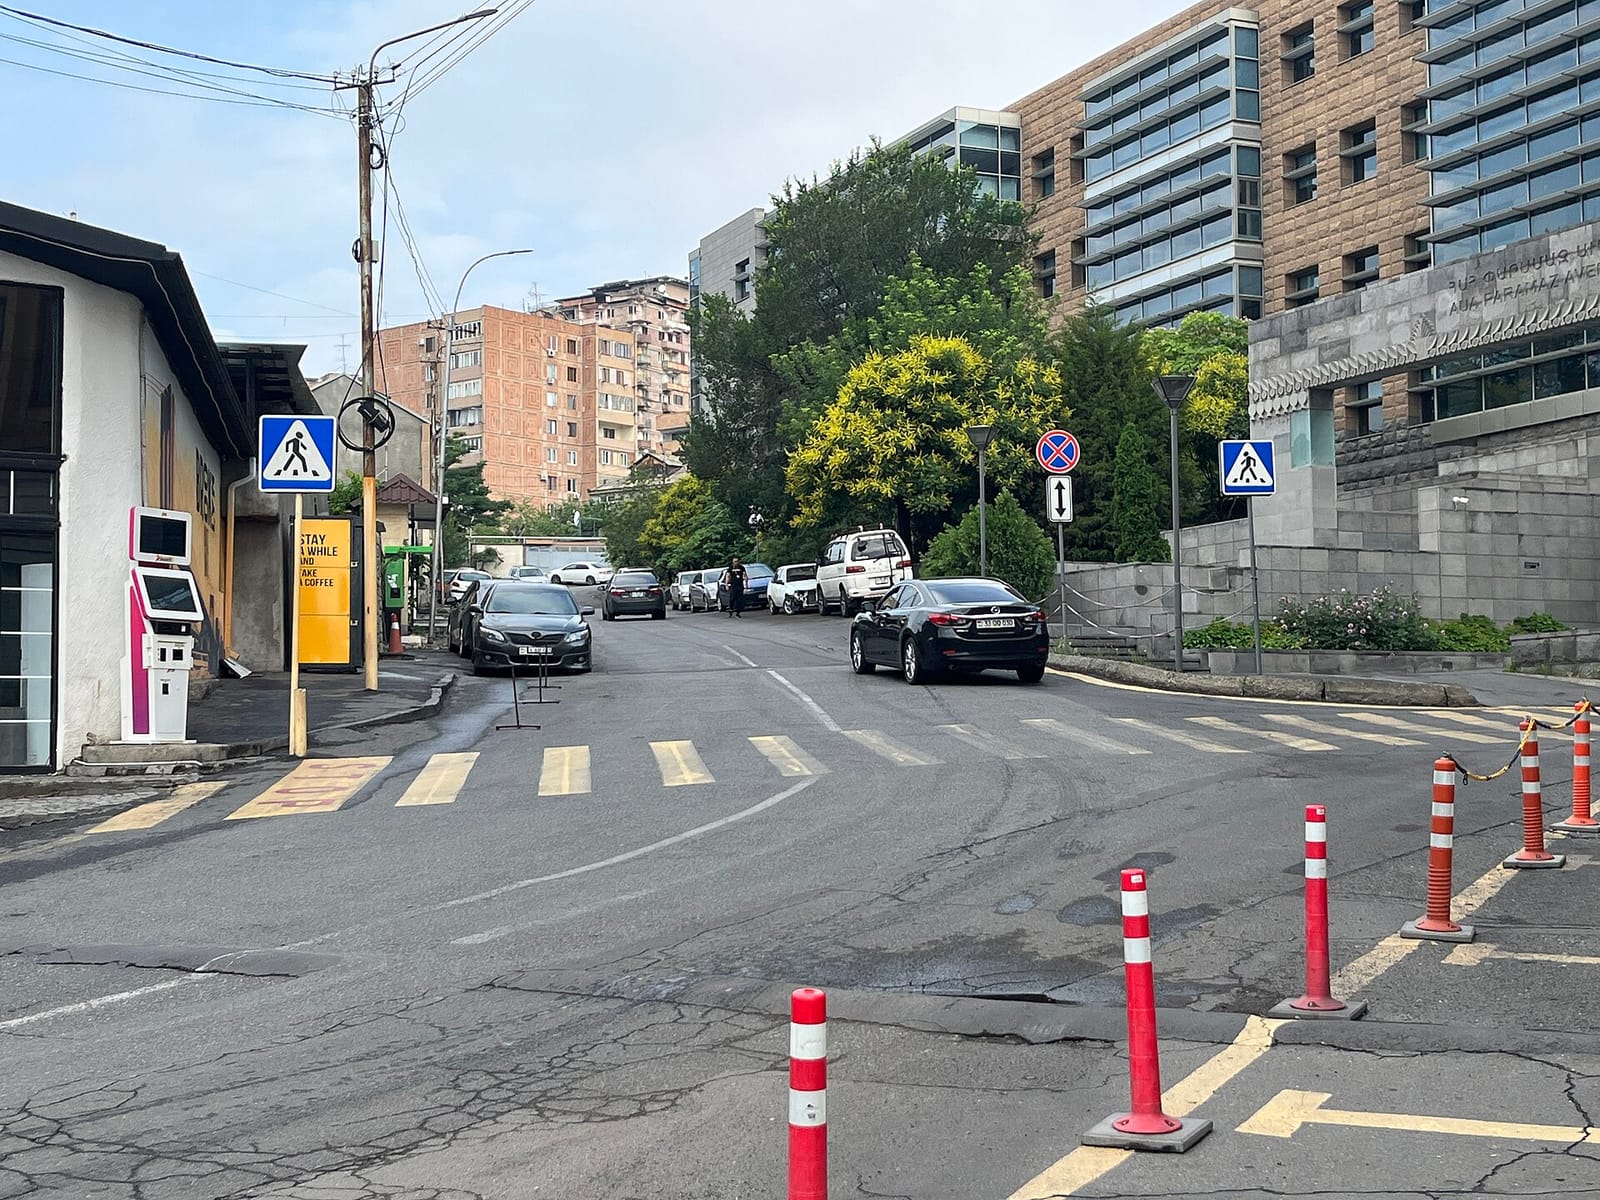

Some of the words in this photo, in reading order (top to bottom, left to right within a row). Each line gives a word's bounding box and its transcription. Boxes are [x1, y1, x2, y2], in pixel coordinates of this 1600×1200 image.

[1449, 295, 1479, 316] AUA
[301, 534, 326, 545] STAY
[308, 547, 338, 556] WHILE
[304, 578, 334, 586] COFFEE
[256, 763, 377, 808] STOP
